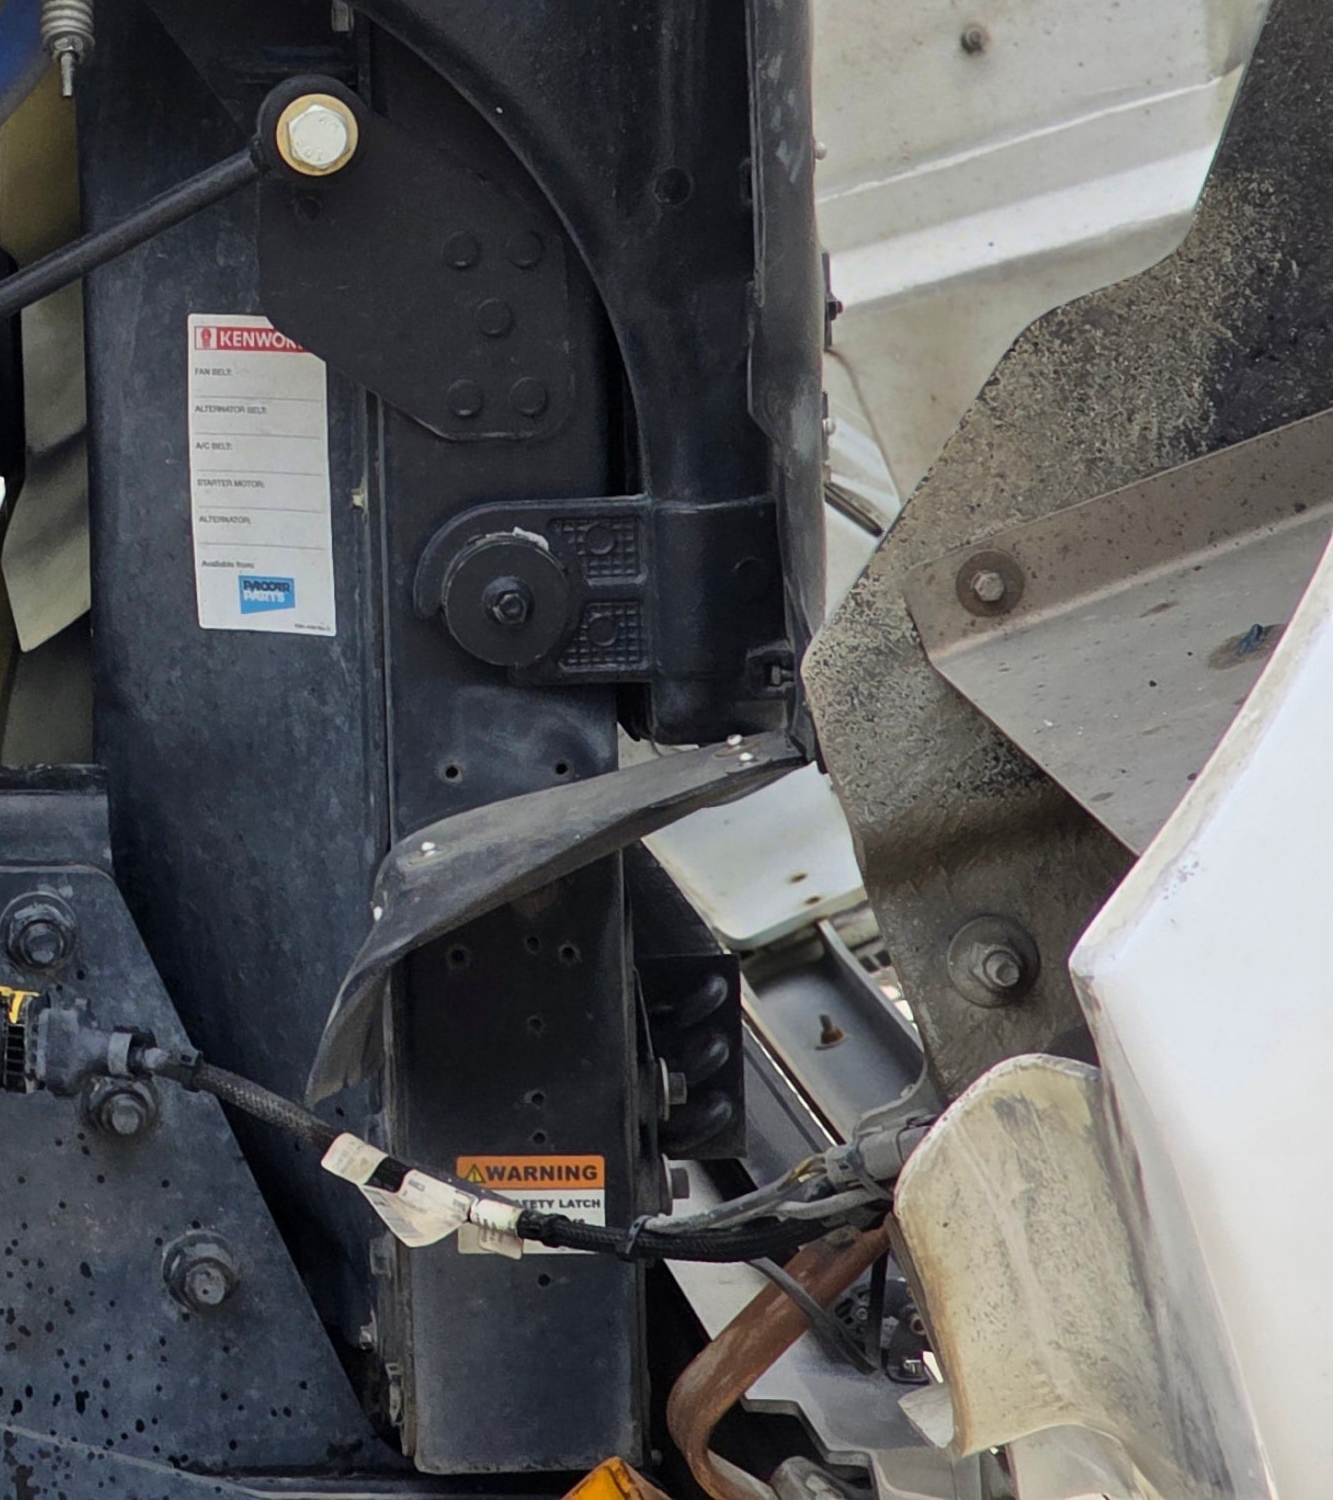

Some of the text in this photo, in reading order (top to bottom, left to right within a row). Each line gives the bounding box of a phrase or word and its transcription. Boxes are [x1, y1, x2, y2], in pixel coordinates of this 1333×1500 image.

[195, 405, 245, 413] ALTERNATOR
[197, 479, 232, 487] STARTER
[201, 560, 234, 568] Available
[243, 580, 290, 592] PACCAR
[243, 591, 286, 603] PARTS
[485, 1165, 598, 1181] WARNING
[559, 1198, 601, 1209] LATCH
